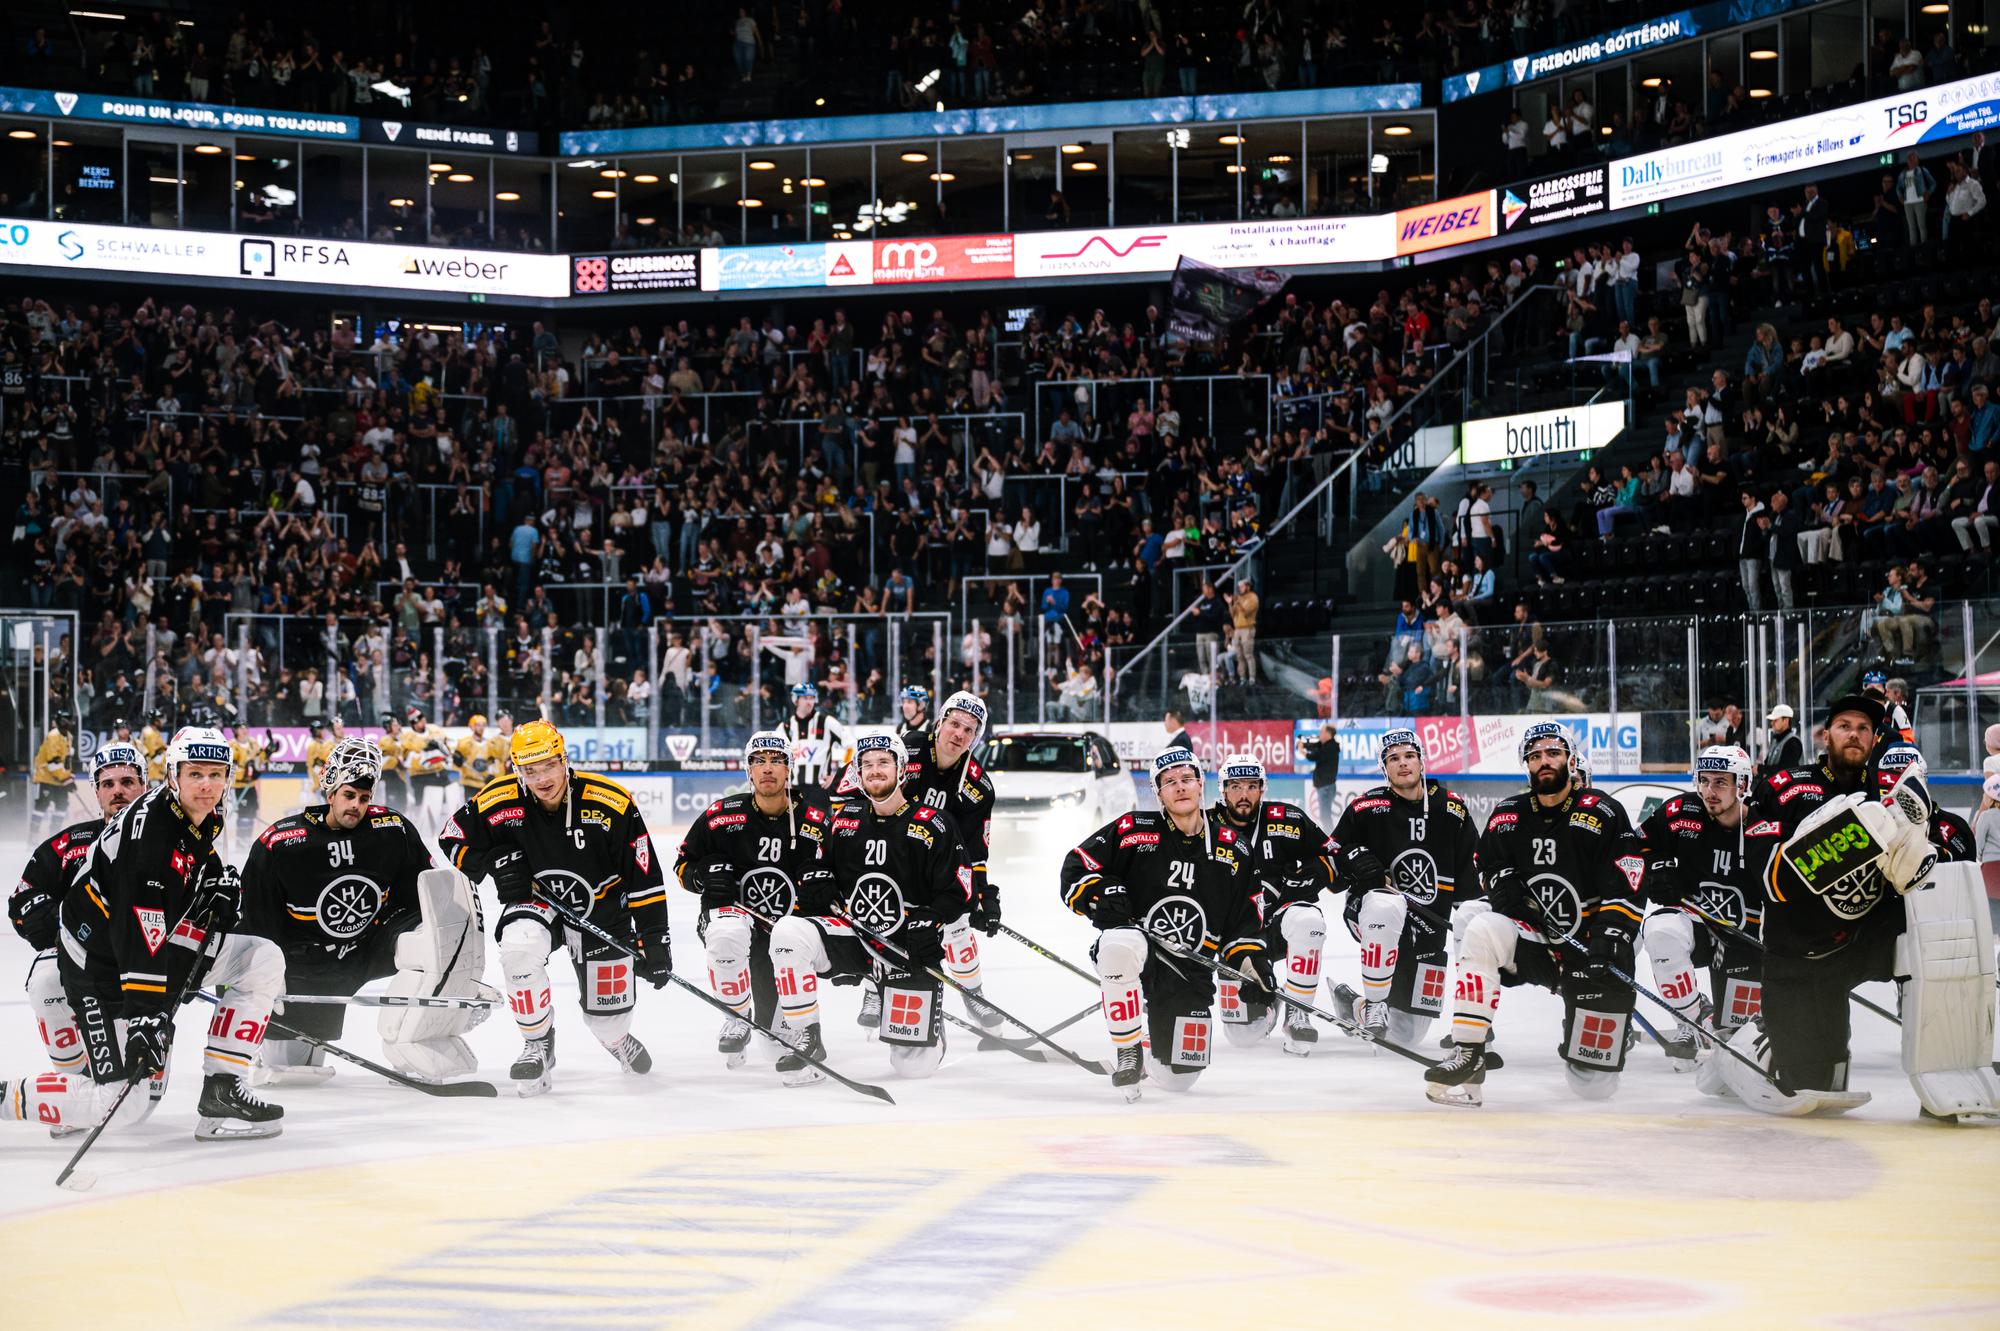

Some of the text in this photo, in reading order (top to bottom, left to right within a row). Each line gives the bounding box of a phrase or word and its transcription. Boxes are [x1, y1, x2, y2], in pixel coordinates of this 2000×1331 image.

[1531, 20, 1680, 75] FRIBOURG-GOTTÉRON
[102, 102, 347, 134] POUR UN JOUR, POUR TOUJOURS
[1884, 101, 1927, 128] TSG
[416, 128, 494, 145] RENÉ FASEL
[1757, 138, 1844, 168] Fromagerie de Billens
[1529, 169, 1604, 198] CARROSSERIE
[1230, 224, 1294, 236] Installation
[1401, 206, 1482, 241] WEIBEL
[97, 239, 207, 257] SCHWALLER
[1280, 235, 1336, 248] Chauffage
[284, 244, 350, 266] RFSA
[422, 256, 509, 280] weber
[611, 254, 696, 274] CUISINOX
[4, 372, 23, 385] 86
[1506, 415, 1576, 456] baiutti
[1479, 718, 1503, 737] HOME
[1487, 725, 1515, 746] OFFICE
[752, 737, 785, 748] ARTISA
[857, 736, 891, 749] ARTISA
[1383, 732, 1415, 745] ARTISA
[1592, 725, 1637, 749] MG
[188, 746, 229, 759] ARTISA
[518, 747, 550, 761] PostFinance
[1156, 751, 1192, 768] ARTISA
[1883, 754, 1919, 765] ARTISA
[268, 762, 294, 774] Kolly
[623, 761, 650, 773] Kolly
[1228, 766, 1260, 776] ARTISA
[1698, 757, 1727, 769] ARTISA
[586, 789, 621, 806] PostFinance
[923, 787, 947, 810] 60
[1781, 784, 1822, 802] BOROTALCO
[1802, 793, 1824, 801] ACTIVE
[1267, 823, 1301, 836] DESA
[1408, 818, 1426, 842] 13
[574, 829, 586, 849] C
[327, 840, 355, 868] 34
[757, 836, 782, 863] 28
[864, 839, 887, 866] 20
[1262, 840, 1274, 859] A
[1532, 838, 1556, 866] 23
[1794, 822, 1870, 882] Gehri
[1619, 859, 1644, 868] GUESS
[1713, 849, 1731, 875] 14
[204, 877, 242, 889] CCM
[1167, 860, 1195, 890] 24
[20, 893, 52, 915] CC
[1838, 900, 1870, 914] LUGANO
[336, 917, 368, 932] LUGANO
[907, 919, 933, 930] CM
[586, 944, 609, 957] CCM
[1416, 953, 1435, 961] CCM
[1291, 949, 1319, 976] ail
[1726, 966, 1750, 974] CCM
[888, 972, 911, 980] CCM
[1455, 972, 1483, 1004] ail
[1661, 971, 1693, 999] ail
[596, 994, 628, 1006] Studio B
[1109, 988, 1139, 1022] ail
[1420, 996, 1436, 1007] Studio
[83, 996, 114, 1076] GUESS
[888, 1024, 919, 1036] Studio B
[1181, 1051, 1200, 1061] Studio
[1578, 1046, 1611, 1060] Studio B
